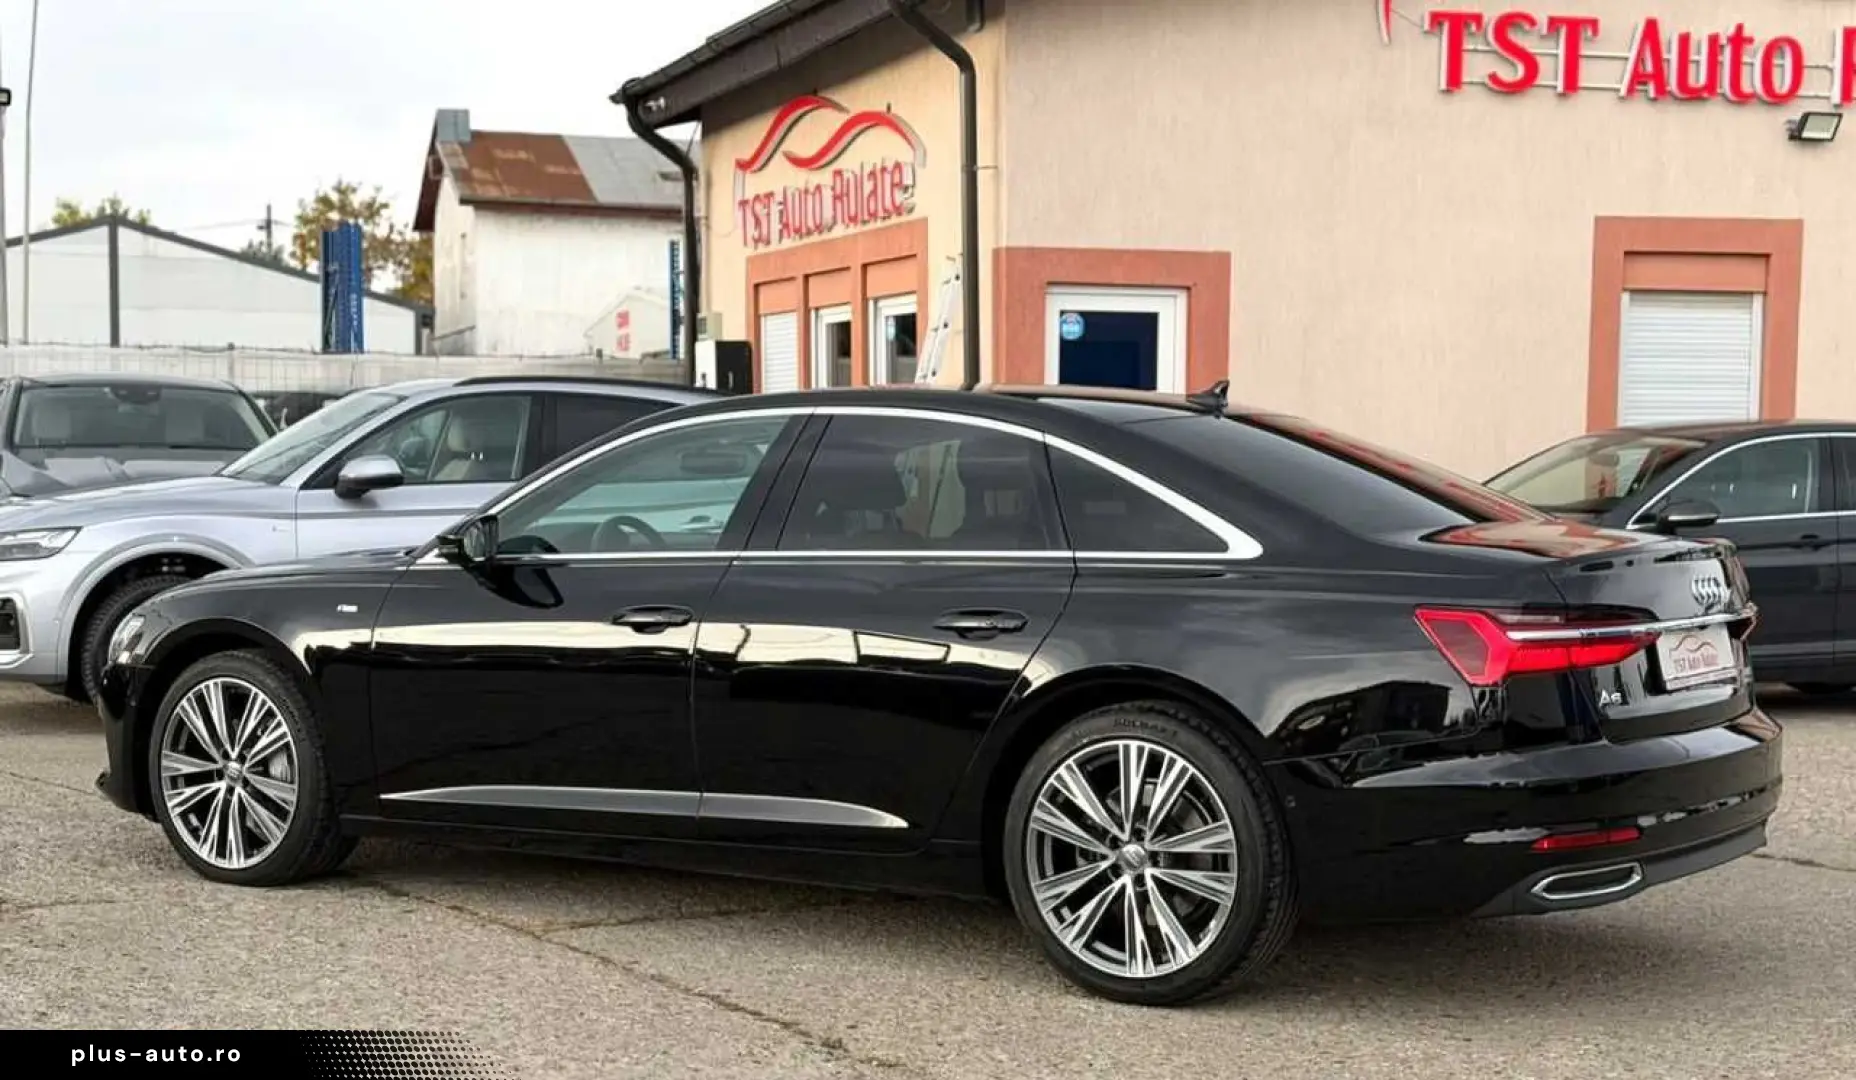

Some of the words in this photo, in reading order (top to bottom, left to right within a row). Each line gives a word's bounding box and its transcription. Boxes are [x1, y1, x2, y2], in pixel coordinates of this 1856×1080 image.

[1425, 11, 1599, 96] TST
[1618, 17, 1805, 104] Auto
[738, 190, 775, 248] TST
[778, 182, 825, 242] Auto
[832, 159, 908, 229] Rulate
[1599, 689, 1622, 706] A6
